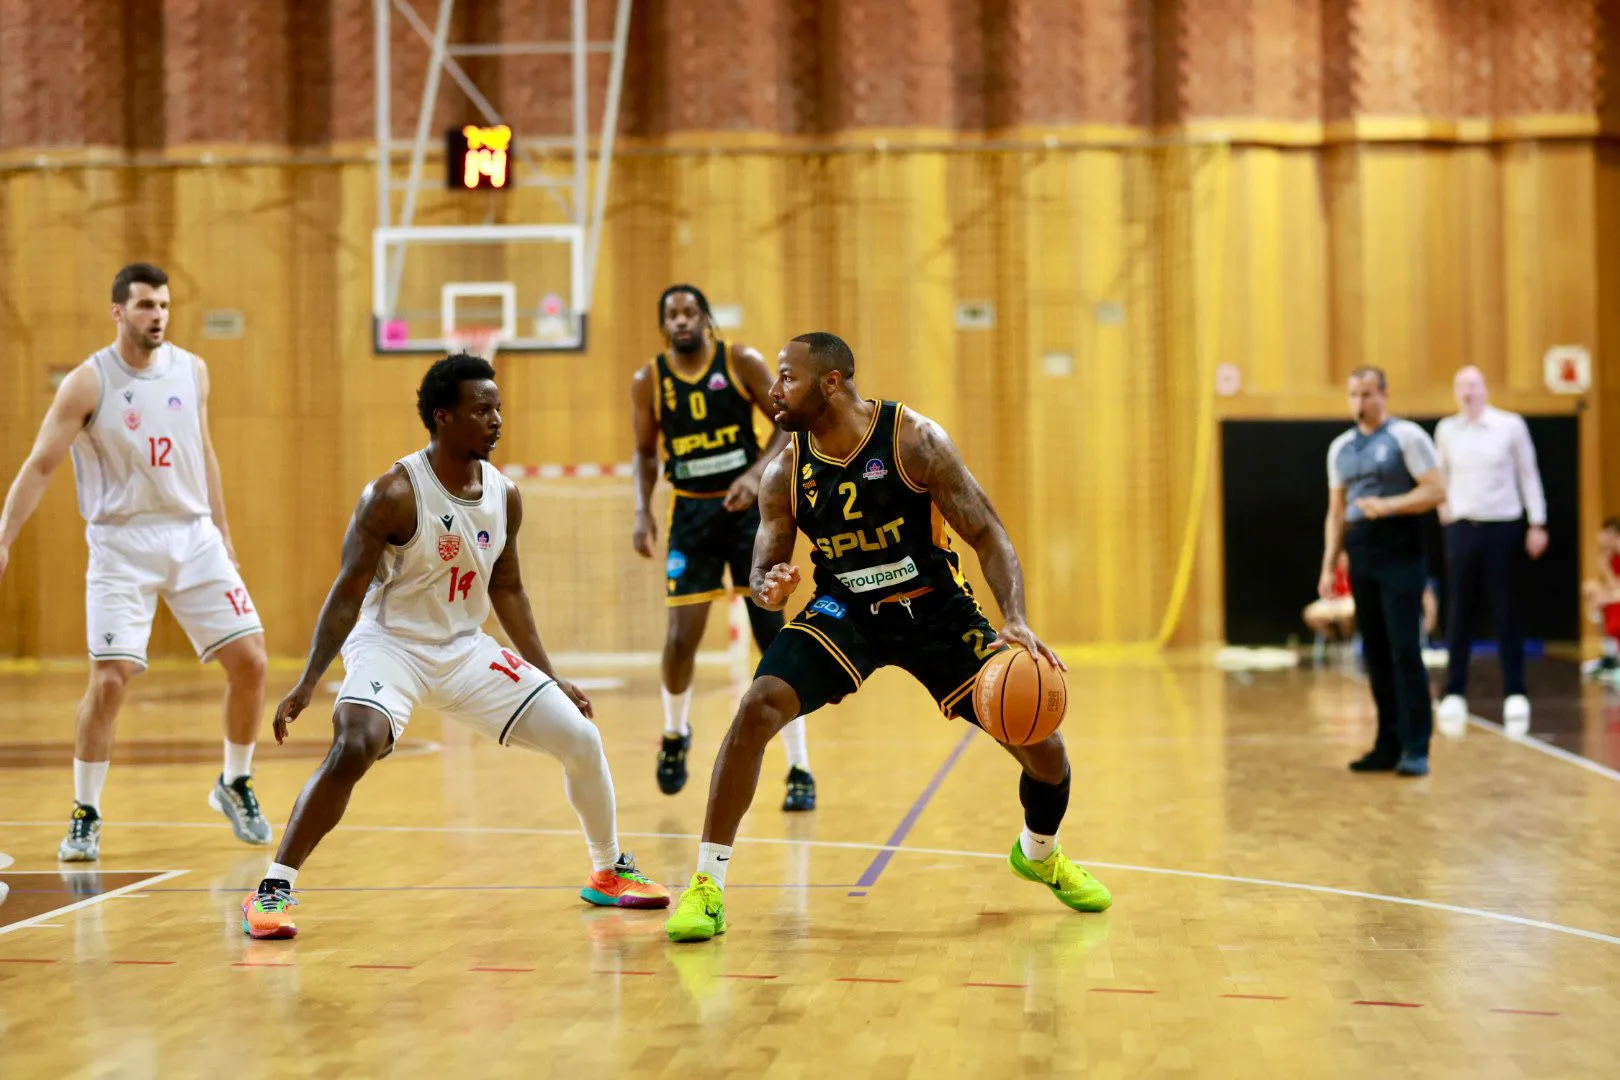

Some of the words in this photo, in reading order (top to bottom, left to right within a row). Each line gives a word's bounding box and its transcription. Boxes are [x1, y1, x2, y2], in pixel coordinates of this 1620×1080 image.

[689, 391, 707, 420] 0
[148, 436, 172, 468] 12
[672, 424, 740, 456] SPLIT
[838, 481, 863, 520] 2
[816, 517, 905, 560] SPLIT
[448, 567, 477, 602] 14
[839, 562, 915, 588] Groupama
[223, 588, 253, 616] 12
[962, 628, 995, 660] 2
[489, 649, 532, 683] 14
